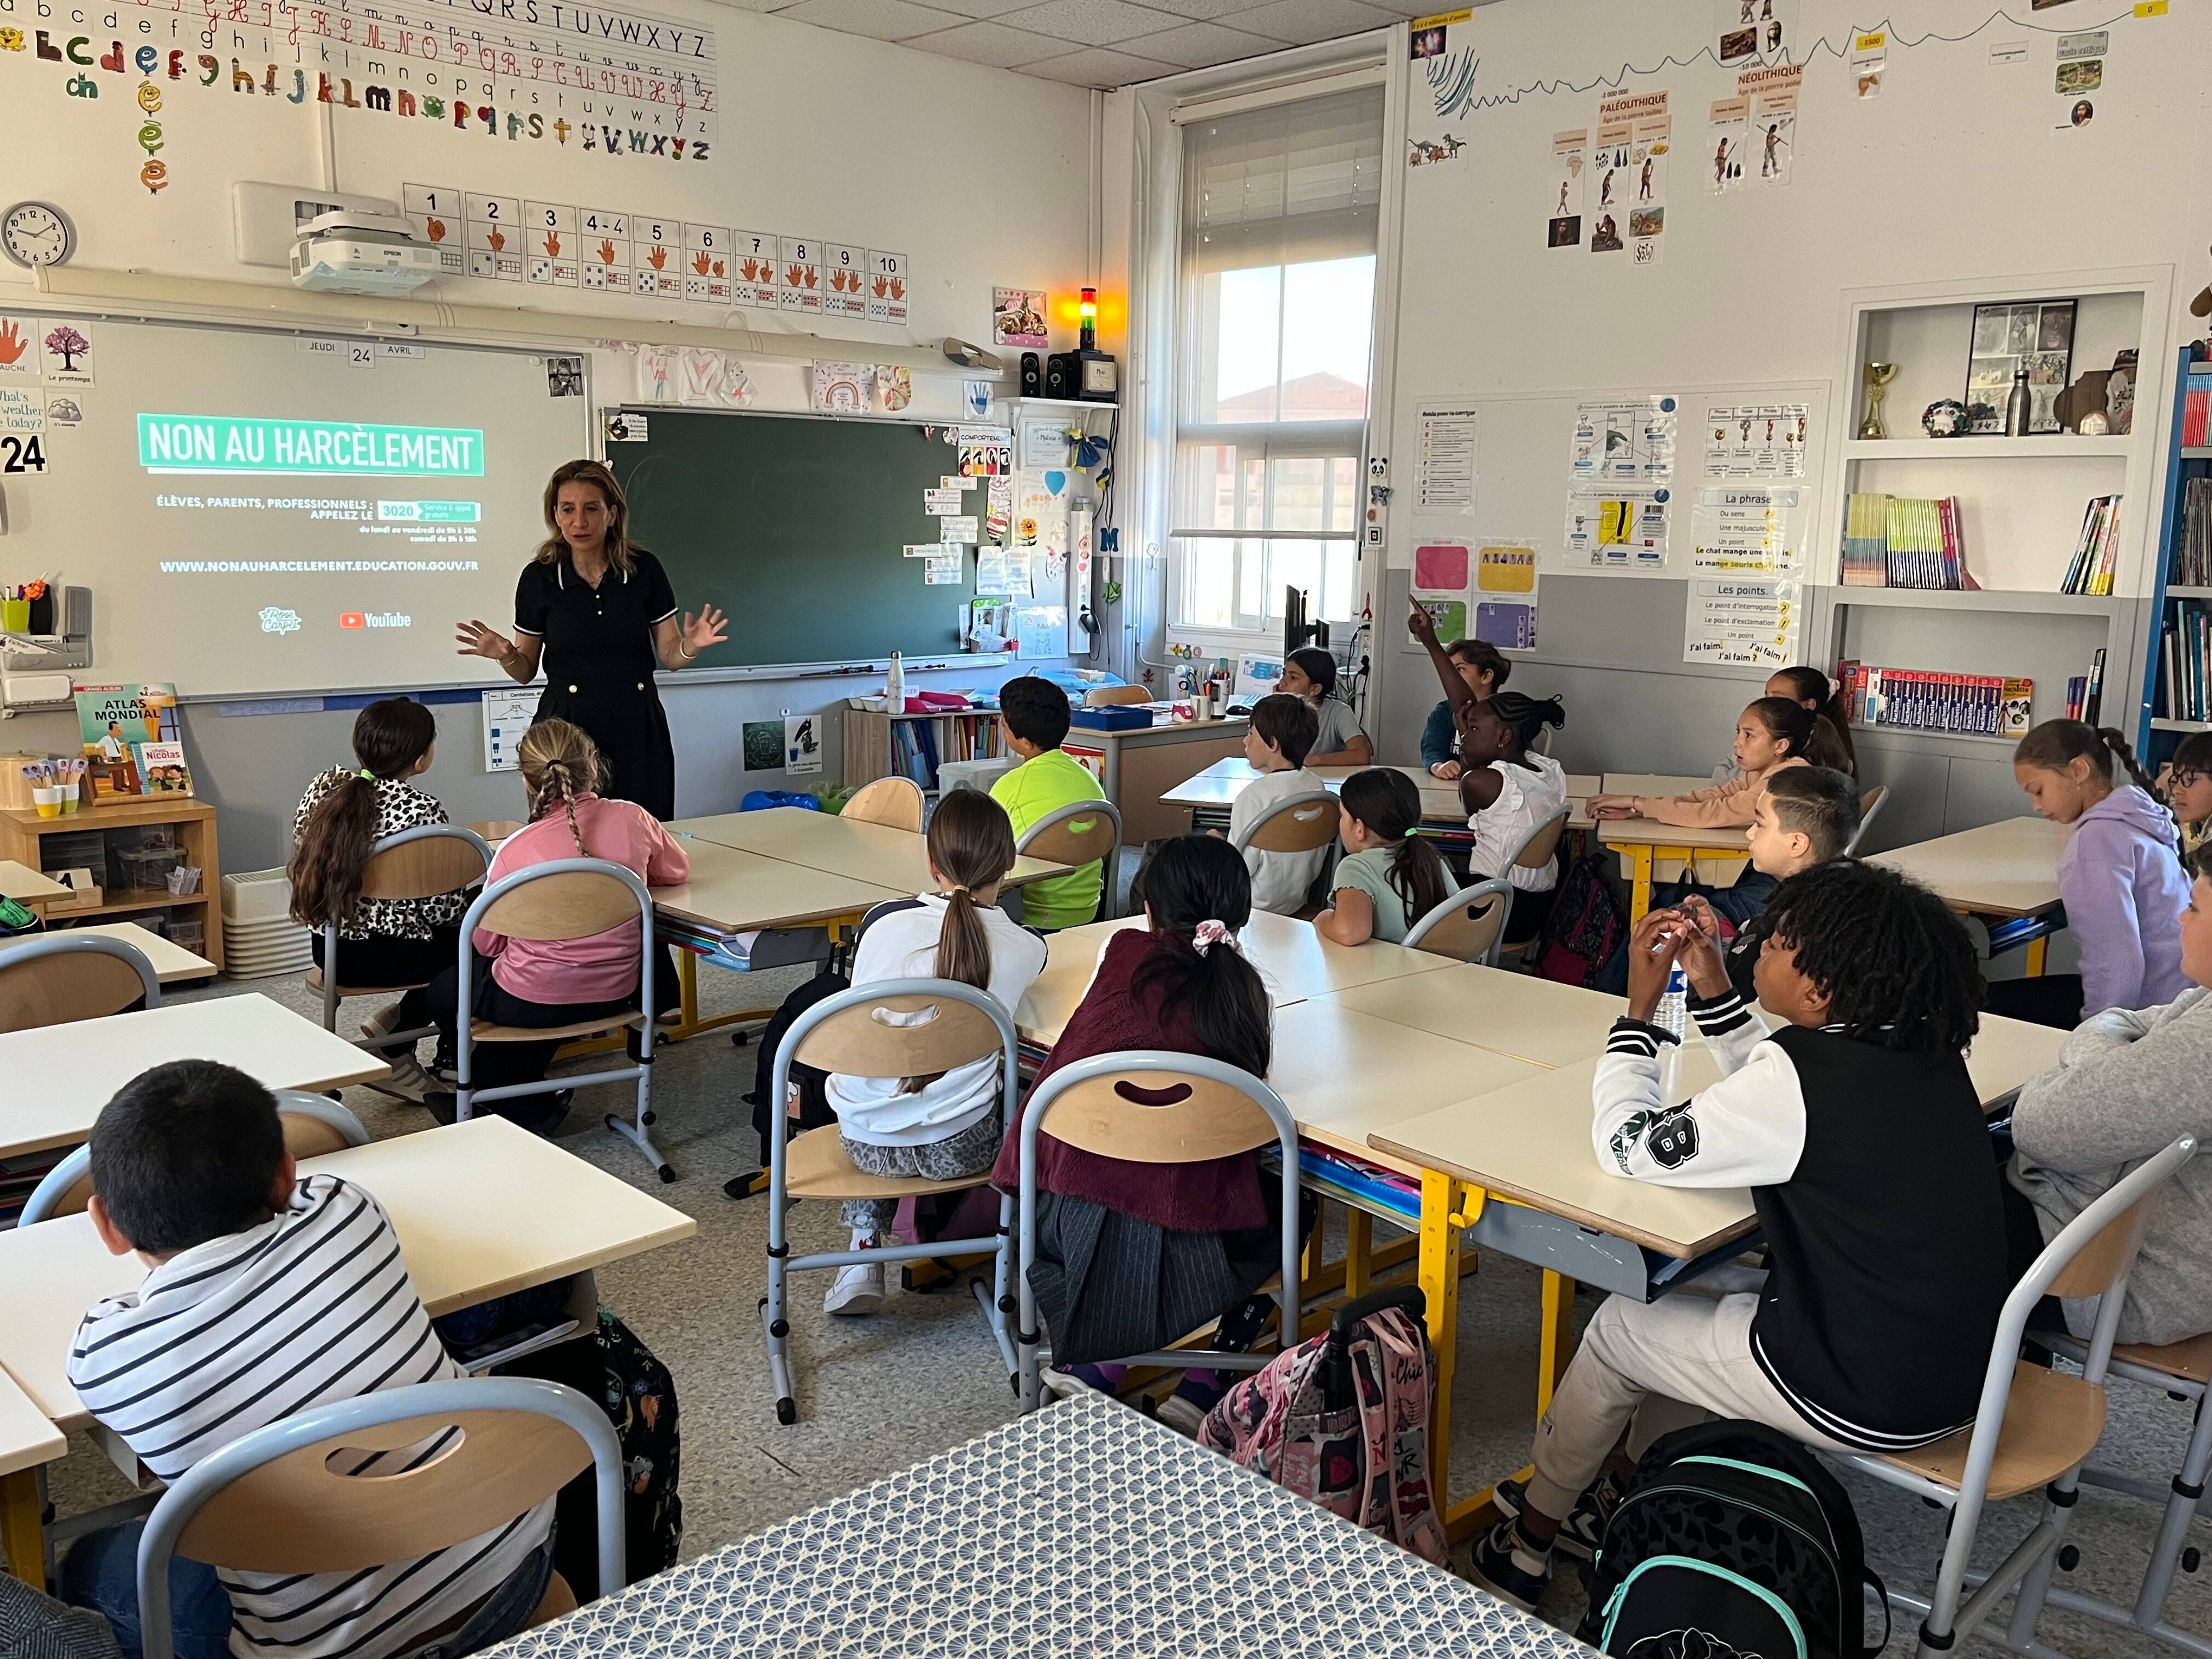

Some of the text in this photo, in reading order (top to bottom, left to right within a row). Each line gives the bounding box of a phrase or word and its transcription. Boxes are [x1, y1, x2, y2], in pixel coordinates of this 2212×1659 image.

[1, 0, 244, 49] a b c d e f g h
[472, 0, 704, 58] Q R S T U V W X Y Z
[1738, 65, 1802, 84] NÉOLITHIQUE
[1600, 94, 1666, 113] PALÉOLITHIQUE
[428, 194, 436, 210] 1
[488, 202, 499, 219] 2
[545, 210, 556, 227] 3
[586, 216, 597, 231] 4
[613, 218, 623, 234] 4
[652, 225, 662, 240] 5
[704, 232, 713, 247] 6
[752, 239, 760, 253] 7
[797, 245, 806, 259] 8
[841, 251, 849, 266] 9
[879, 257, 896, 273] 10
[310, 342, 412, 362] JEUDI 24 AVRIL
[2, 405, 43, 416] weather
[7, 417, 42, 430] today?
[149, 422, 473, 470] NON AU HARCÈLEMENT
[1, 436, 45, 473] 24
[157, 494, 204, 509] ÉLÈVES,
[207, 498, 265, 510] PARENTS,
[268, 499, 367, 510] PROFESSIONNELS
[1726, 495, 1771, 504] La phrase
[311, 510, 373, 521] APPELEZ LE
[383, 506, 413, 516] 3020
[1100, 527, 1119, 552] M
[160, 560, 479, 572] WWW.NONAUHARCELEMENT.EDUCATION.GOUV.FR
[1718, 585, 1768, 596] Les points.
[269, 608, 295, 619] Rose
[1733, 603, 1779, 611] d'interrogation
[263, 618, 301, 631] Carpet
[364, 612, 411, 628] YouTube
[1733, 653, 1751, 662] faim
[1763, 648, 1781, 661] faim
[105, 699, 146, 709] ATLAS
[95, 709, 161, 720] MONDIAL
[146, 751, 180, 760] Nicolas
[1396, 1358, 1424, 1385] Chic
